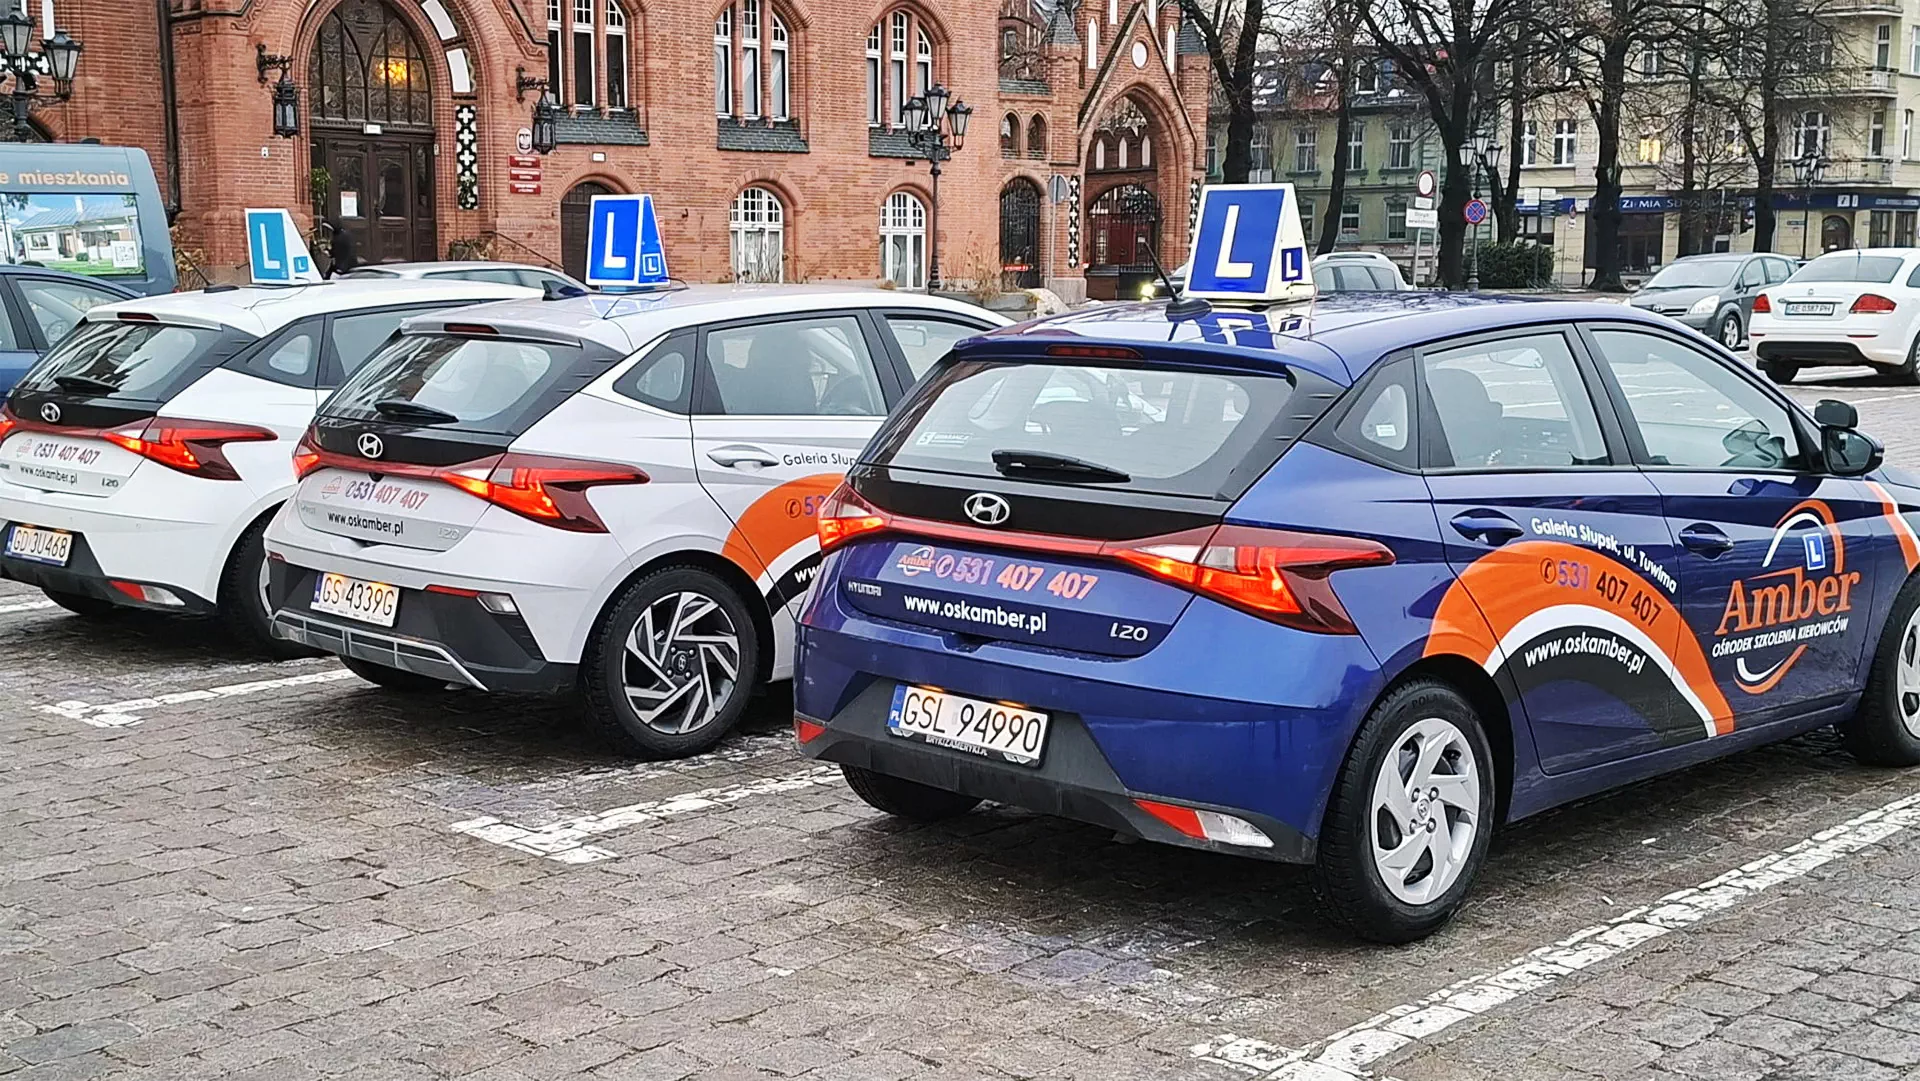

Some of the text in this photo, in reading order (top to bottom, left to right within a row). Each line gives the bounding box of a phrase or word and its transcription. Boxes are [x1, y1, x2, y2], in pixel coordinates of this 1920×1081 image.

[18, 169, 129, 186] mieszkania
[1622, 199, 1660, 208] ZIMIA
[260, 223, 280, 269] L
[603, 212, 626, 268] L
[1215, 205, 1253, 278] L
[298, 259, 306, 270] L
[648, 258, 658, 271] L
[1286, 252, 1299, 278] L
[40, 443, 58, 458] 531
[58, 445, 79, 461] 407
[78, 448, 101, 465] 407
[783, 453, 828, 466] Galeria
[21, 466, 78, 485] www.oskamber.pl
[352, 481, 429, 511] 531 407 407
[328, 512, 404, 536] www.oskamber.pl
[14, 530, 68, 558] GD 3U468
[1531, 517, 1578, 539] Galeria
[1623, 545, 1637, 563] ul.
[1639, 552, 1676, 594] Tuwima
[1809, 540, 1821, 563] L
[899, 555, 935, 569] Amber
[952, 557, 1098, 600] 531 407 407
[322, 577, 342, 604] GS
[345, 582, 394, 616] 4339G
[1558, 560, 1662, 627] 531 407 407
[1714, 566, 1861, 636] Amber
[904, 595, 1047, 634] www.oskamber.pl
[1712, 614, 1849, 658] OŚRODEK SZKOLENIA KIEROWCÓW
[1524, 631, 1647, 675] www.oskamber.pl
[890, 709, 900, 721] PL
[903, 692, 1041, 753] GSL 94990
